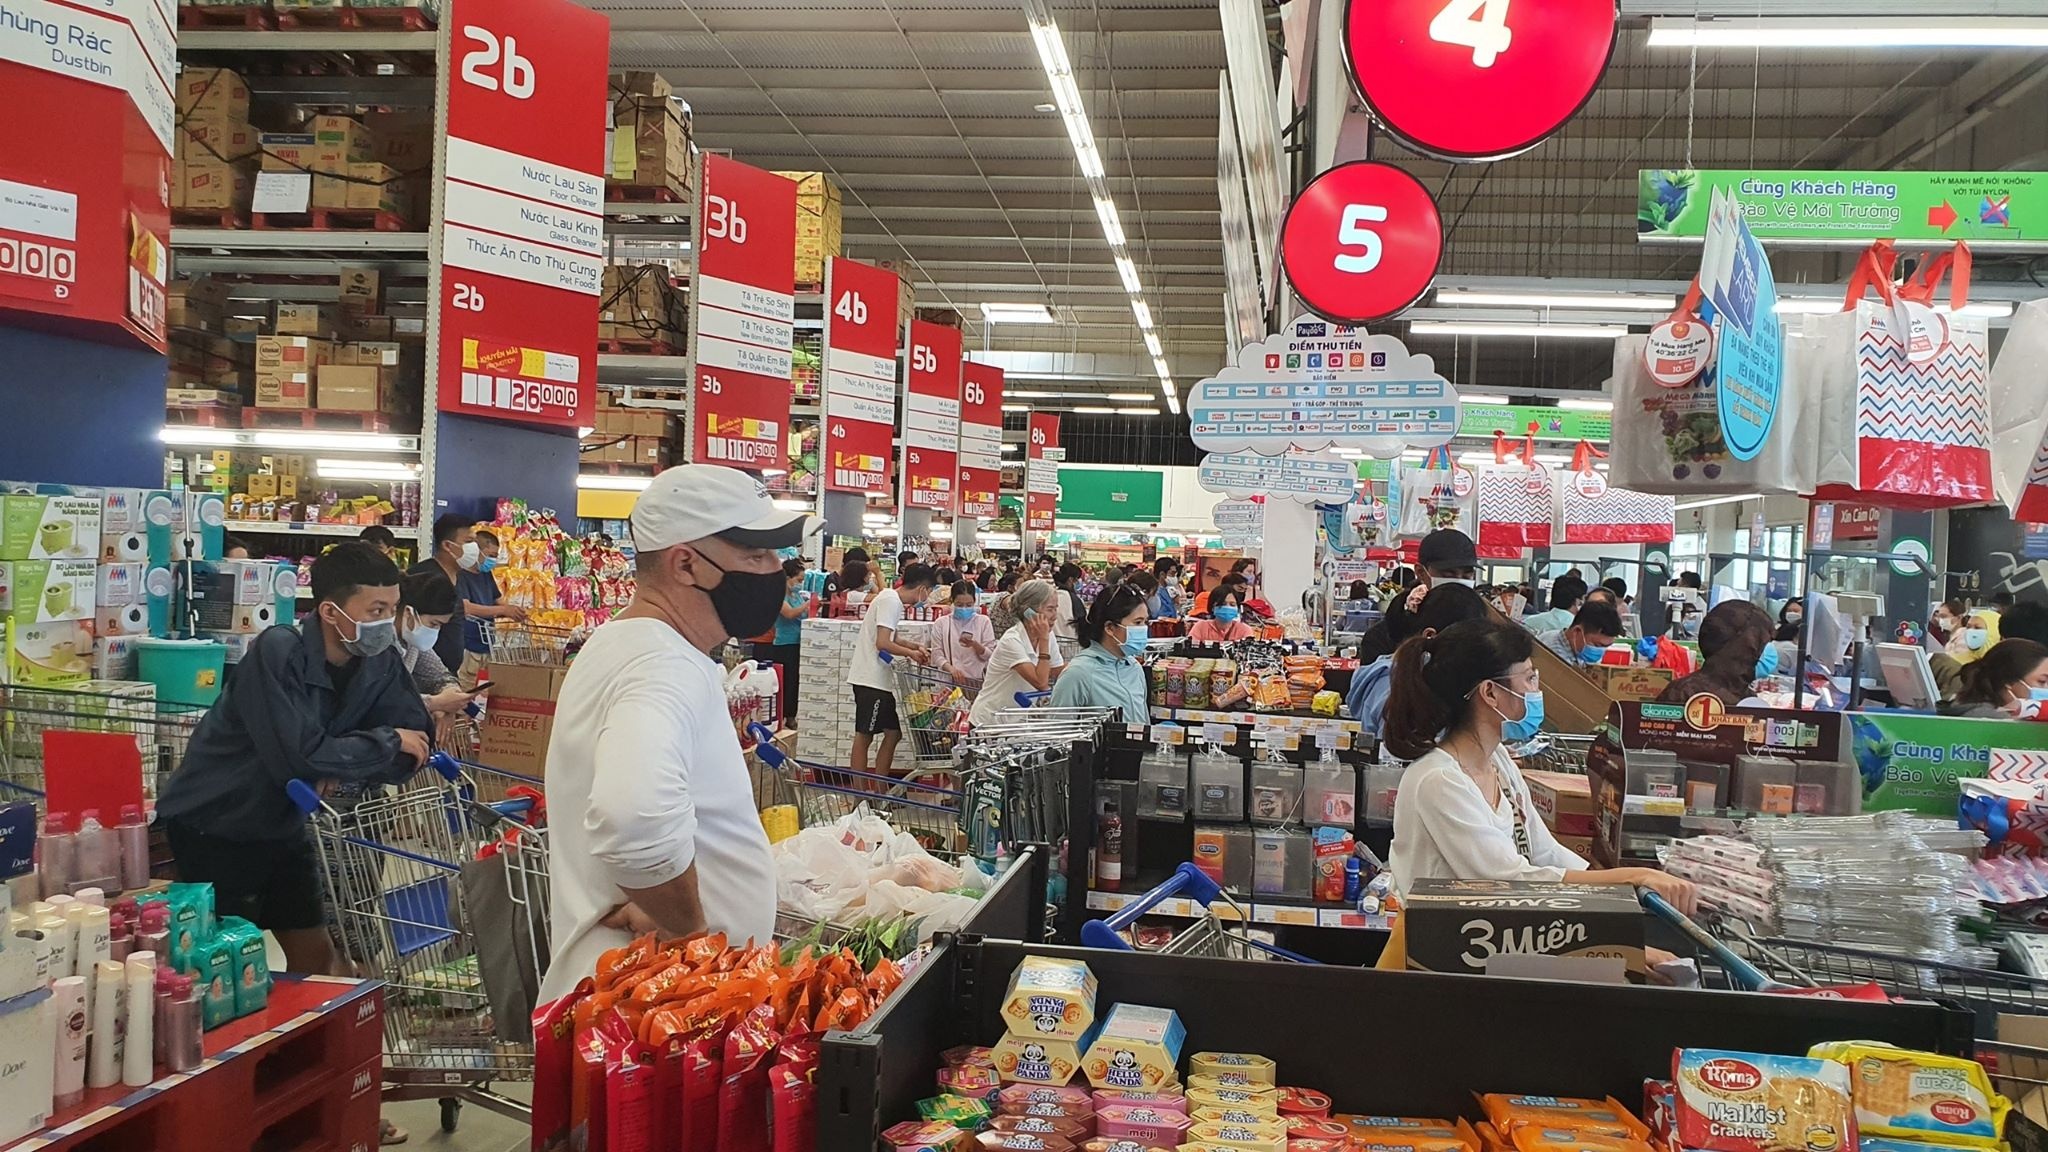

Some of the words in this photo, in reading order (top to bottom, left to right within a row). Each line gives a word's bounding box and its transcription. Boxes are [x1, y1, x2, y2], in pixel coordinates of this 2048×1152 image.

[68, 25, 112, 54] Rác
[1429, 0, 1512, 68] 4
[52, 48, 112, 76] Dustbin
[462, 25, 535, 99] 2b
[523, 165, 551, 184] Nước
[554, 174, 575, 190] Lau
[1741, 178, 1784, 199] Cùng
[1791, 179, 1846, 196] Khách
[1851, 181, 1897, 199] Hàng
[1983, 188, 2010, 196] NYLON
[550, 189, 569, 201] Floor
[570, 194, 597, 208] Cleaner
[520, 207, 549, 225] Nước
[552, 215, 573, 230] Lau
[1774, 202, 1797, 219] Vệ
[1803, 201, 1832, 217] Môi
[707, 194, 747, 244] 3b
[549, 230, 569, 242] Glass
[570, 235, 597, 249] Cleaner
[1334, 204, 1387, 273] 5
[519, 250, 541, 265] Cho
[559, 274, 573, 285] Pet
[574, 277, 596, 290] Foods
[452, 282, 485, 312] 2b
[777, 298, 791, 310] Sinh
[834, 289, 868, 325] 4b
[776, 327, 790, 337] Sinh
[1317, 342, 1337, 351] THU
[767, 355, 779, 365] Em
[912, 345, 937, 373] 5b
[702, 374, 722, 395] 3b
[965, 382, 985, 405] 6b
[831, 424, 846, 438] 4b
[1031, 427, 1046, 445] 8b
[909, 452, 920, 464] 5b
[1642, 704, 1682, 717] okamoto
[1699, 698, 1711, 727] 1
[1774, 726, 1795, 736] 003
[1893, 740, 1944, 762] Cùng
[1952, 743, 1990, 761] Khá
[1886, 765, 1923, 782] Bảo
[1199, 845, 1219, 853] durex
[12, 857, 31, 869] Dove
[1461, 918, 1496, 968] 3
[1500, 918, 1588, 955] Miền
[1030, 996, 1066, 1007] PANDA
[1030, 1004, 1063, 1015] HELLO
[1006, 1039, 1024, 1048] meiji
[1096, 1046, 1115, 1054] meiji
[2, 1060, 26, 1078] Dove
[1016, 1069, 1051, 1080] PANDA
[1017, 1062, 1050, 1072] HELLO
[1108, 1068, 1141, 1079] HELLO
[1222, 1070, 1247, 1081] meiji
[1107, 1076, 1142, 1087] PANDA
[1707, 1068, 1758, 1086] Roma
[1916, 1076, 1969, 1093] Cream
[1708, 1101, 1787, 1125] Malkist
[1936, 1104, 1971, 1119] Roma
[1128, 1128, 1157, 1139] meiji
[1710, 1123, 1777, 1140] Crackers
